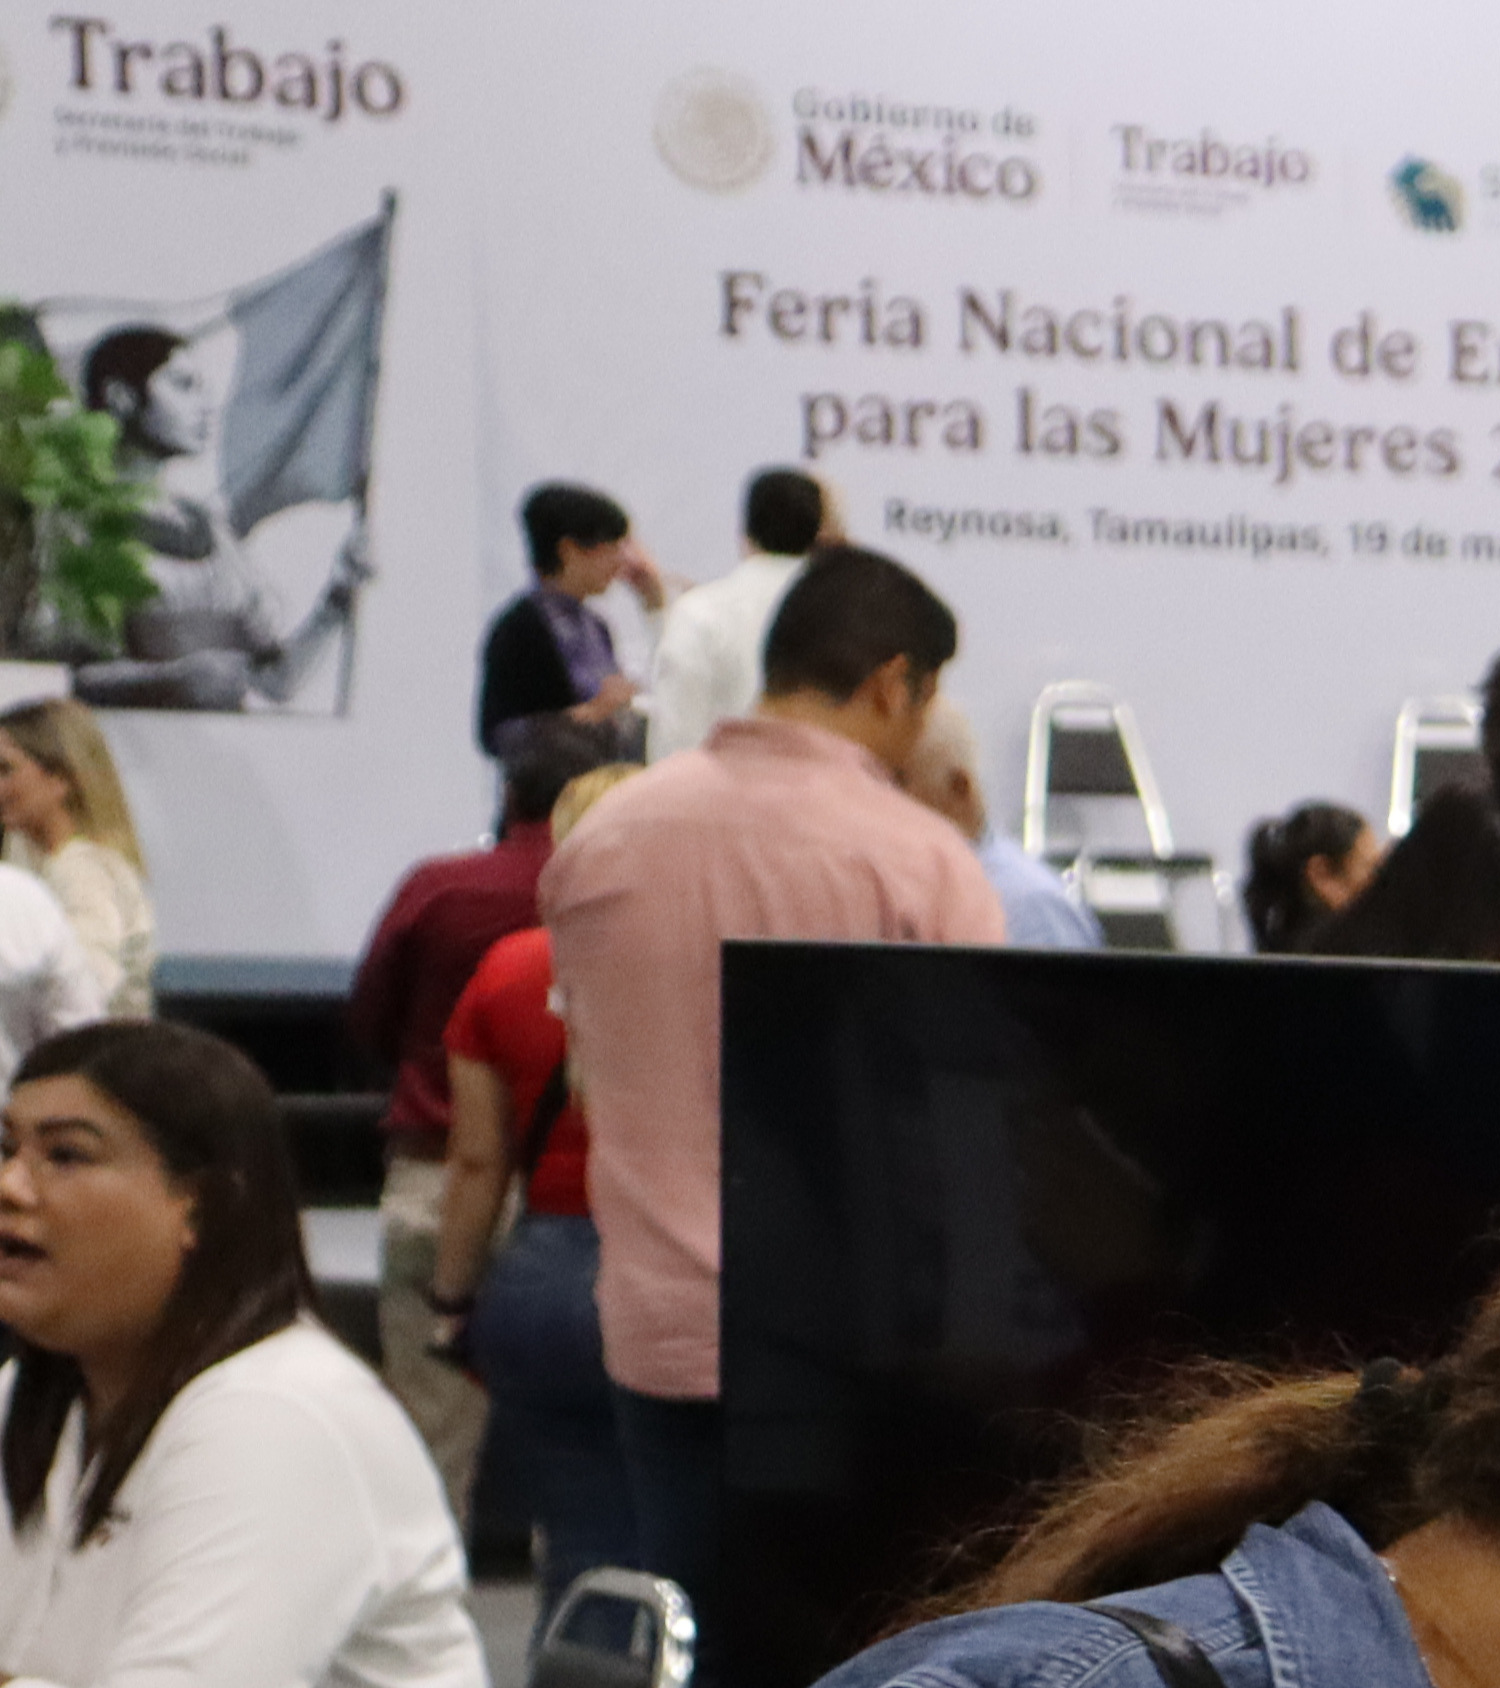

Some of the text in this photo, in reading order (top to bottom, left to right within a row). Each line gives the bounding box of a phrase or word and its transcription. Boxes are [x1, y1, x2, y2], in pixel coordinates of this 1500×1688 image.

[48, 14, 406, 122] Trabajo
[791, 85, 1037, 139] Gobierno de
[794, 122, 1039, 202] México
[1110, 122, 1313, 188] Trabajo
[718, 270, 925, 348] Feria
[957, 286, 1298, 374] Nacional
[1331, 309, 1418, 379] de
[802, 388, 984, 460] para
[1015, 385, 1122, 457] las
[1155, 396, 1462, 486] Mujeres
[884, 498, 1070, 546] Reynosa,
[1088, 508, 1331, 560] Tamaulipas,
[1349, 521, 1388, 556] 19
[1400, 522, 1449, 556] de
